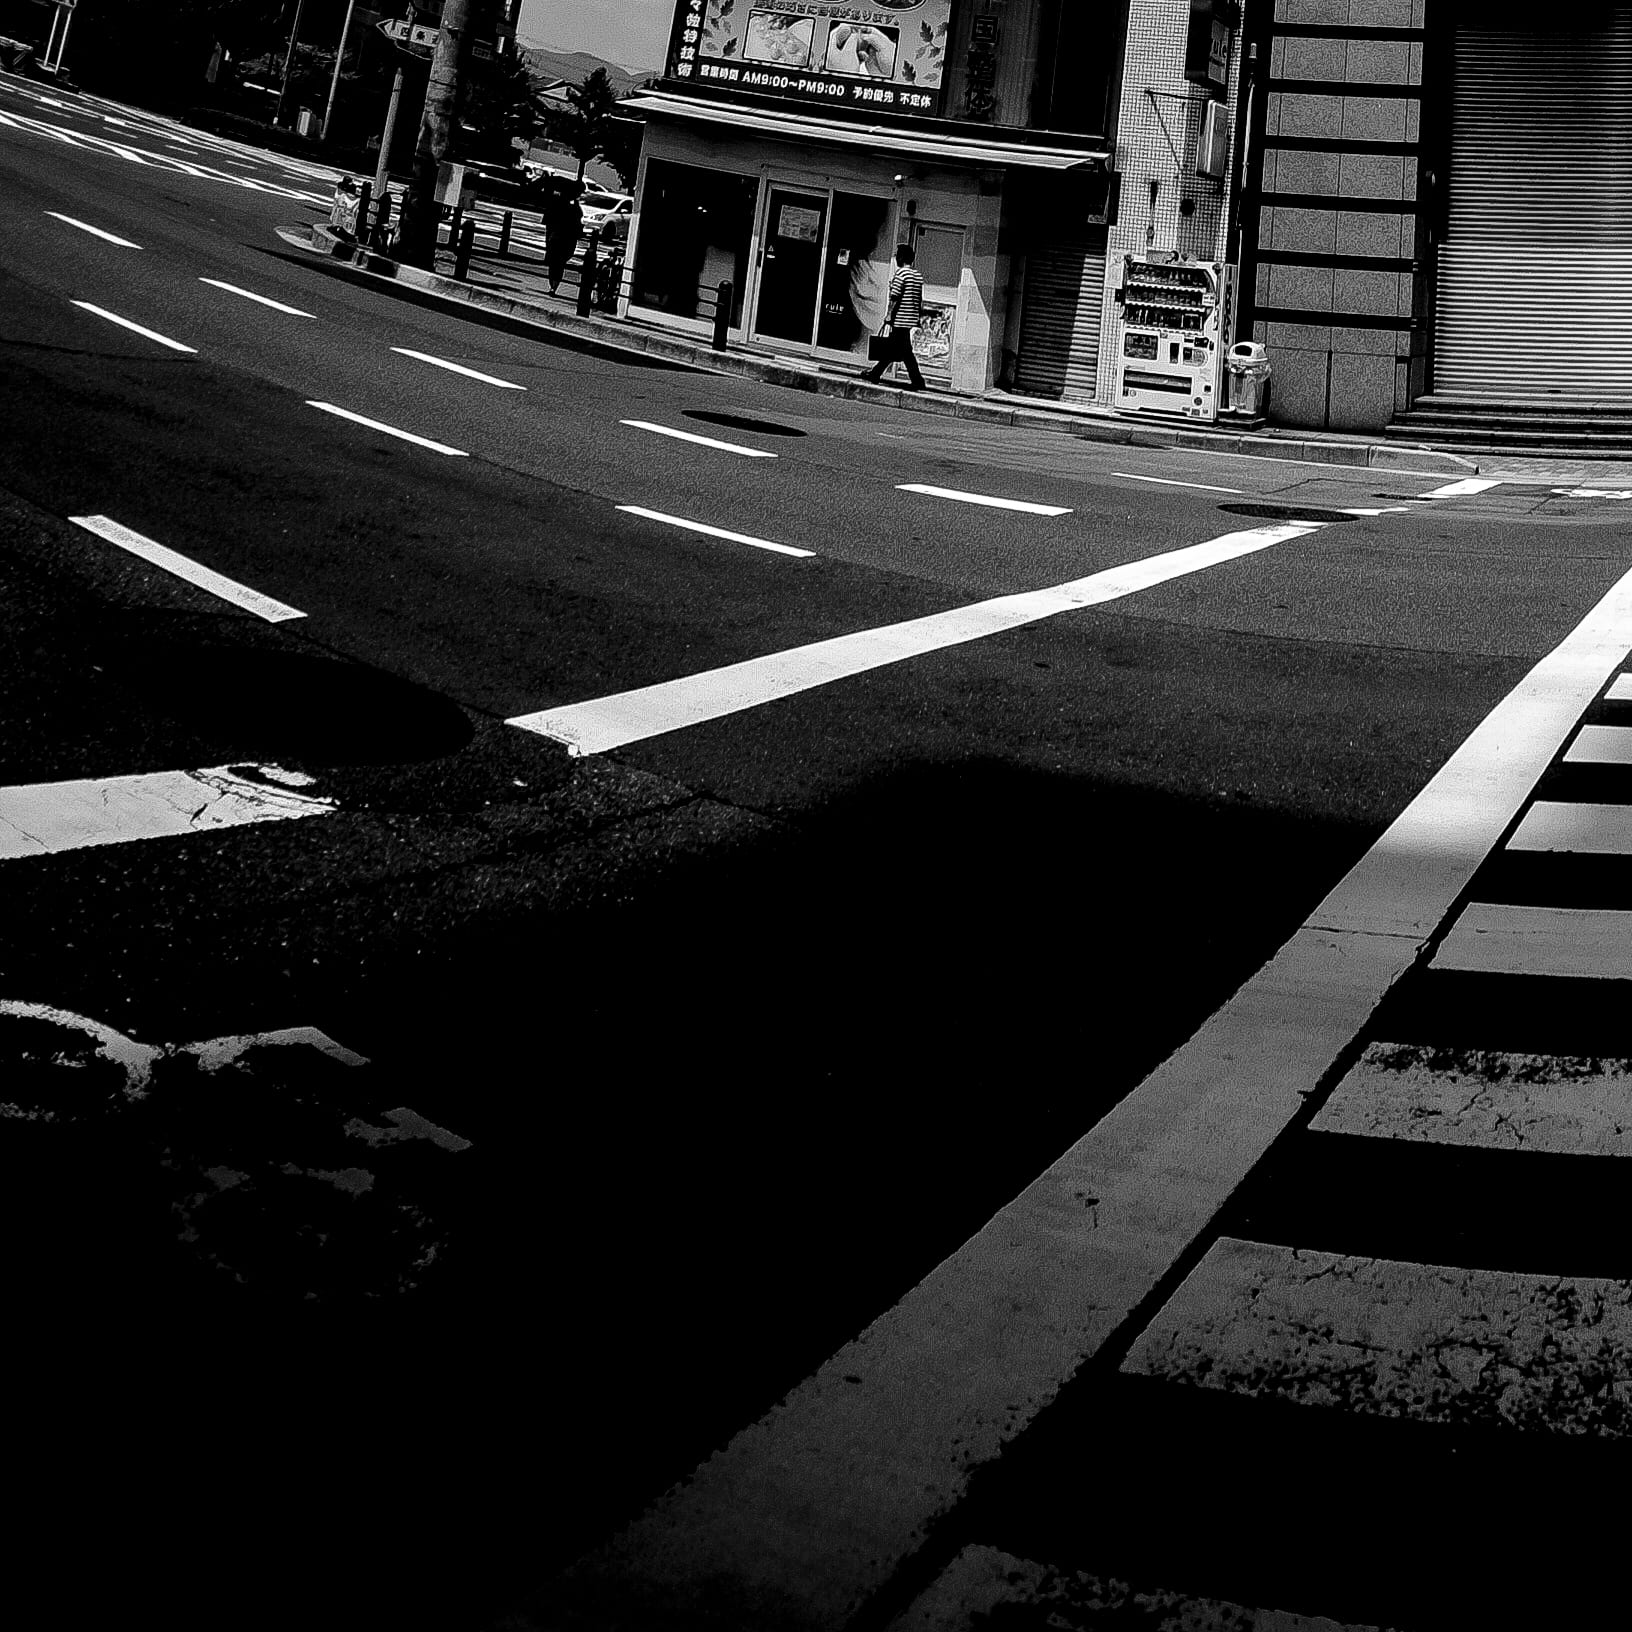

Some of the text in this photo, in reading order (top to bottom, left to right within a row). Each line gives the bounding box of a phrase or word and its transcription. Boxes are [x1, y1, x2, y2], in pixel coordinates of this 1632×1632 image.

[899, 91, 933, 108] 不定休
[825, 303, 845, 312] rule
